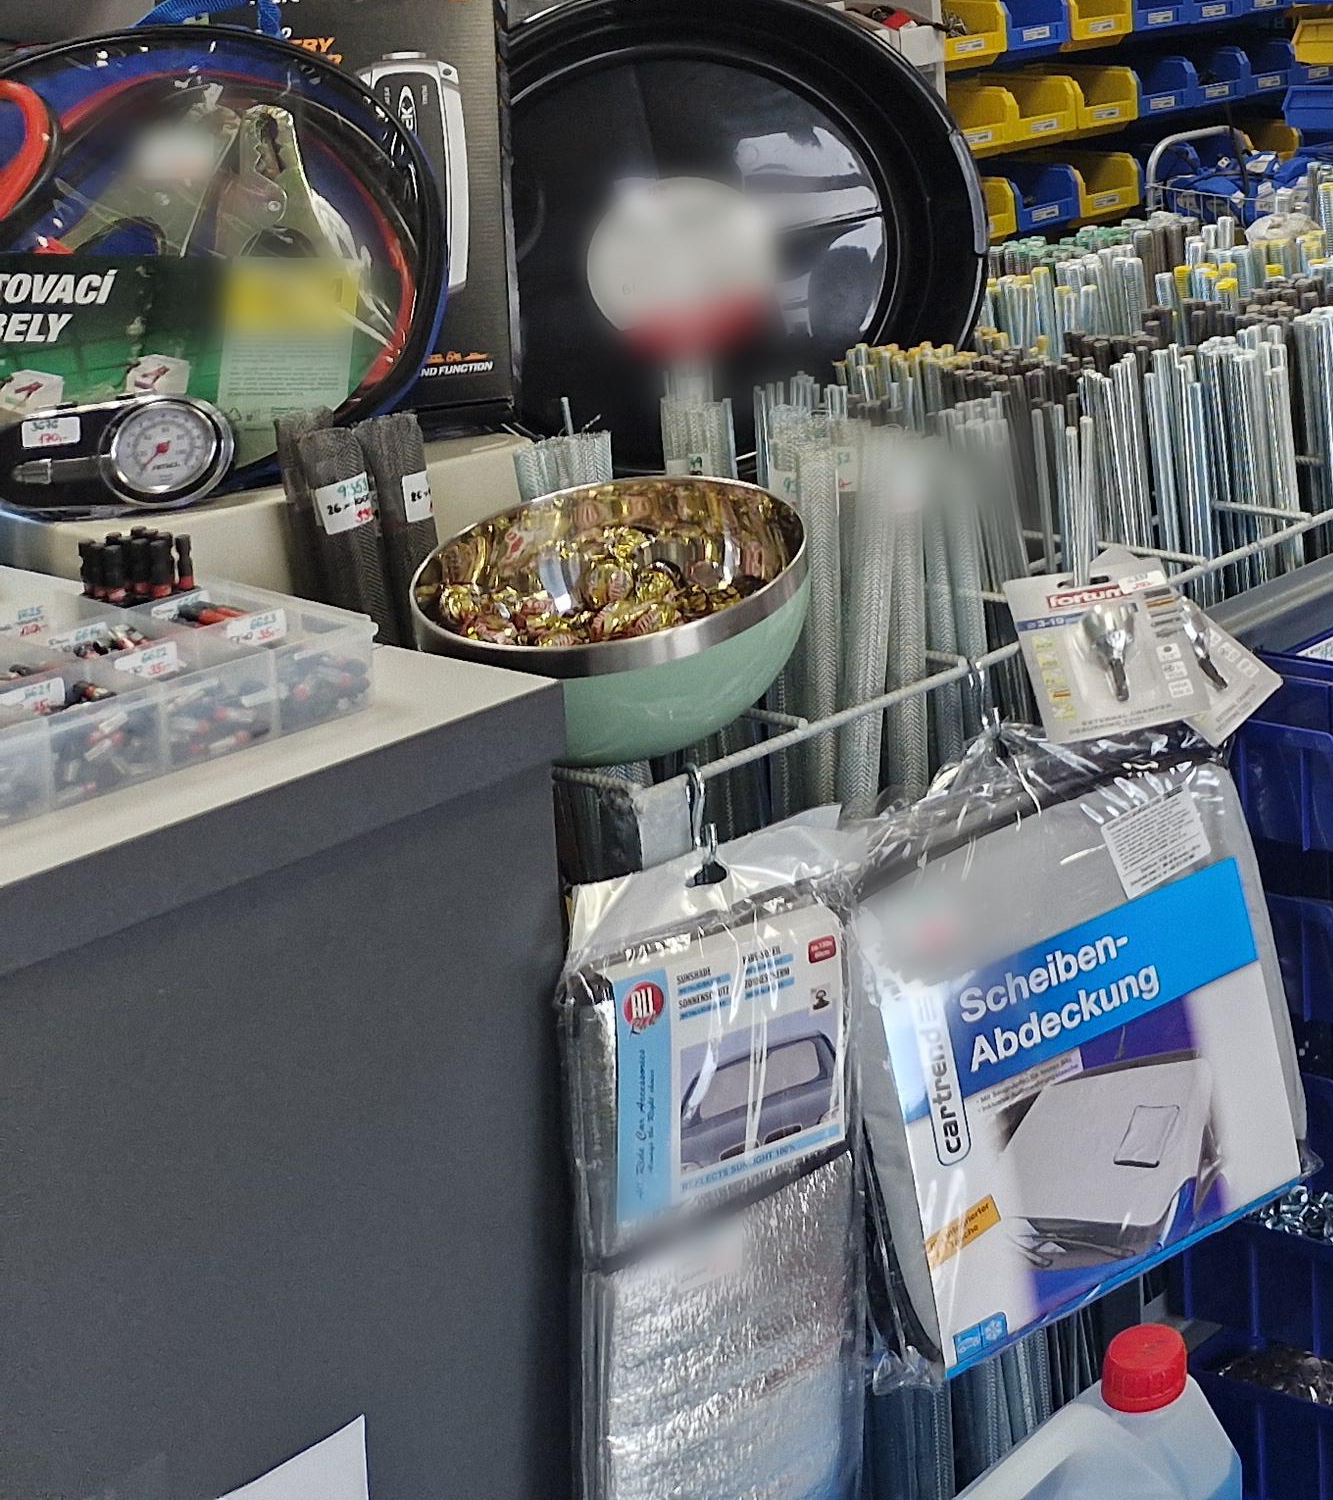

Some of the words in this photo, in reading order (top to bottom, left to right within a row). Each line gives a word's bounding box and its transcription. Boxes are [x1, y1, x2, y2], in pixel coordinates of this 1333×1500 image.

[438, 361, 494, 376] FUNCTION
[676, 968, 712, 985] SUNSHADE
[959, 934, 1130, 1023] Scheiben-
[631, 986, 655, 1020] ALL
[970, 965, 1161, 1073] Abdeckung
[919, 1027, 963, 1154] cartrend
[731, 1153, 773, 1174] SUNIGHT
